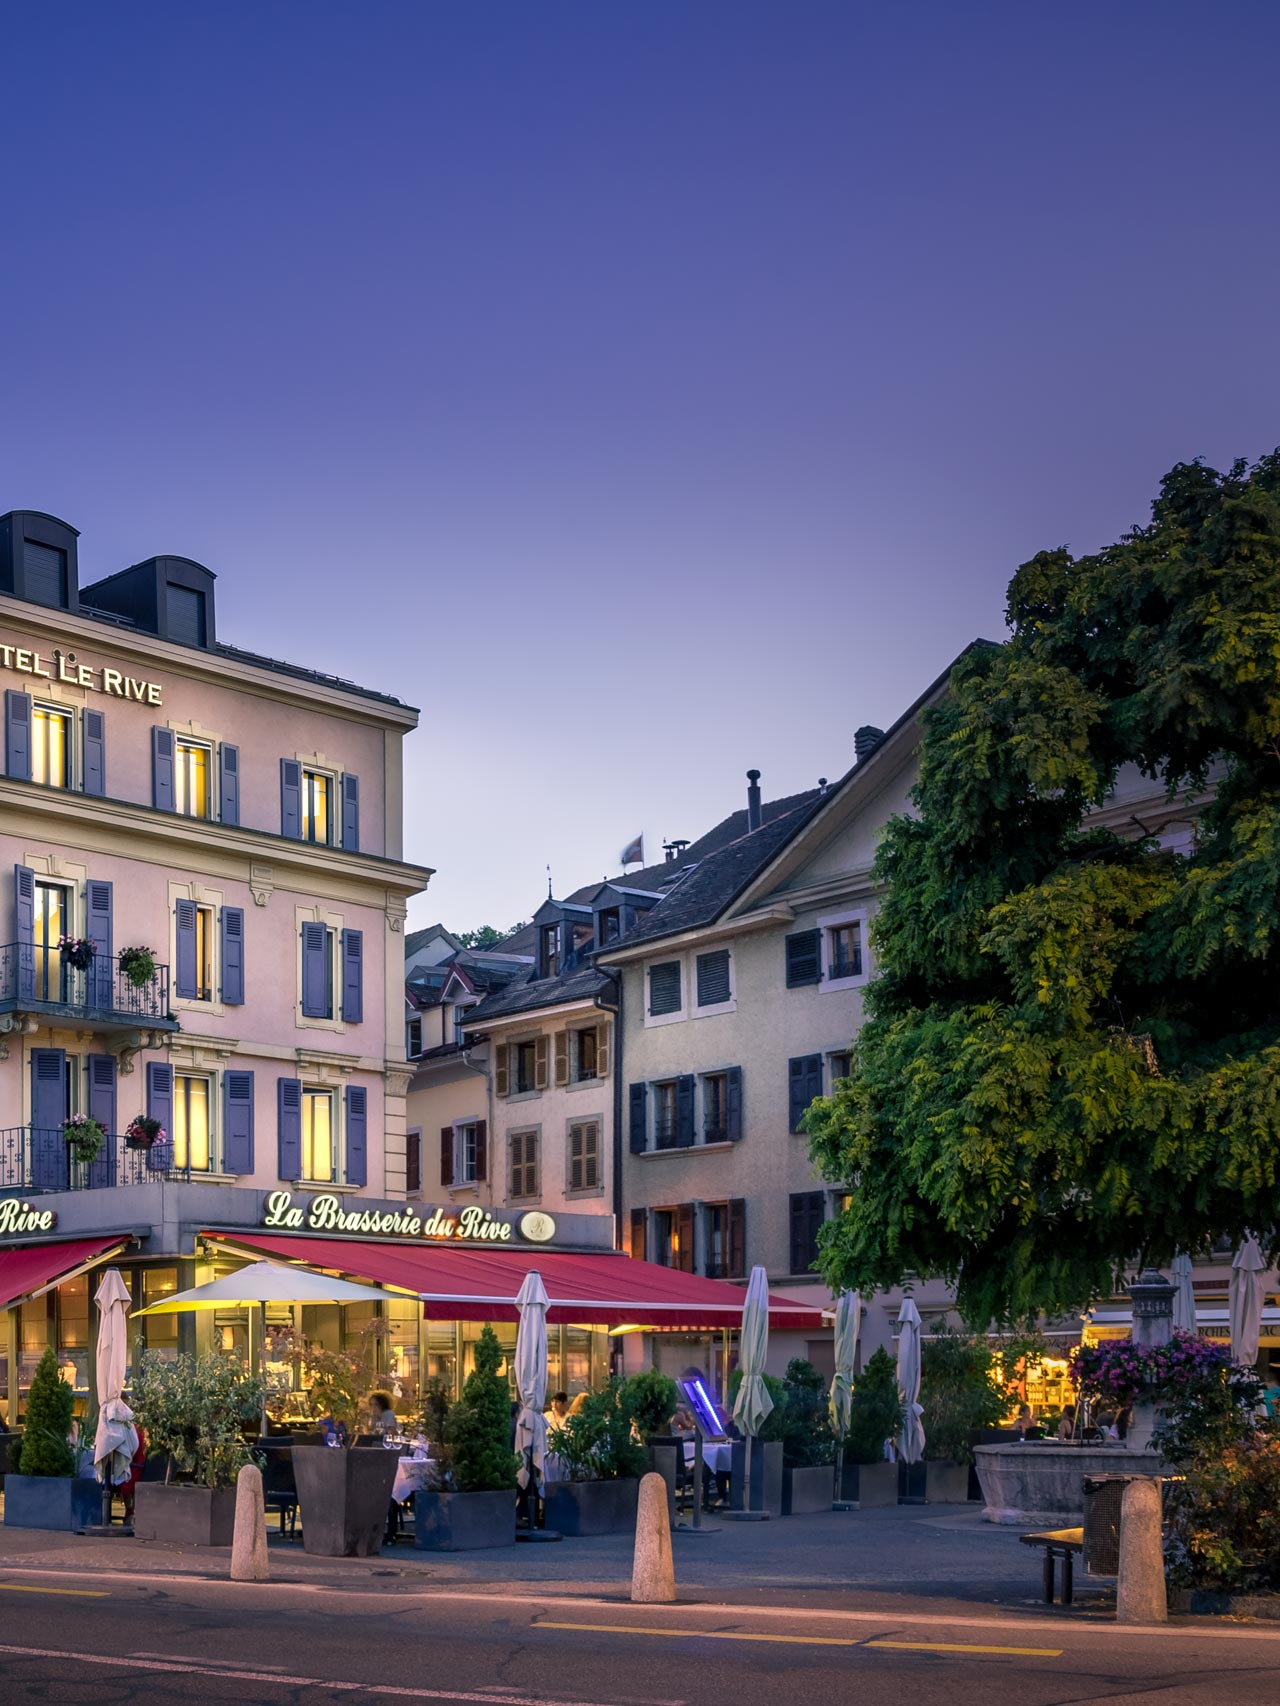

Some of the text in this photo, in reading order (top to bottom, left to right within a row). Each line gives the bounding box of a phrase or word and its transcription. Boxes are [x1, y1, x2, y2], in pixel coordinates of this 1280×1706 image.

[59, 655, 95, 689] LE
[103, 667, 163, 706] RIVE
[265, 1191, 512, 1240] La Brasserie du Rive
